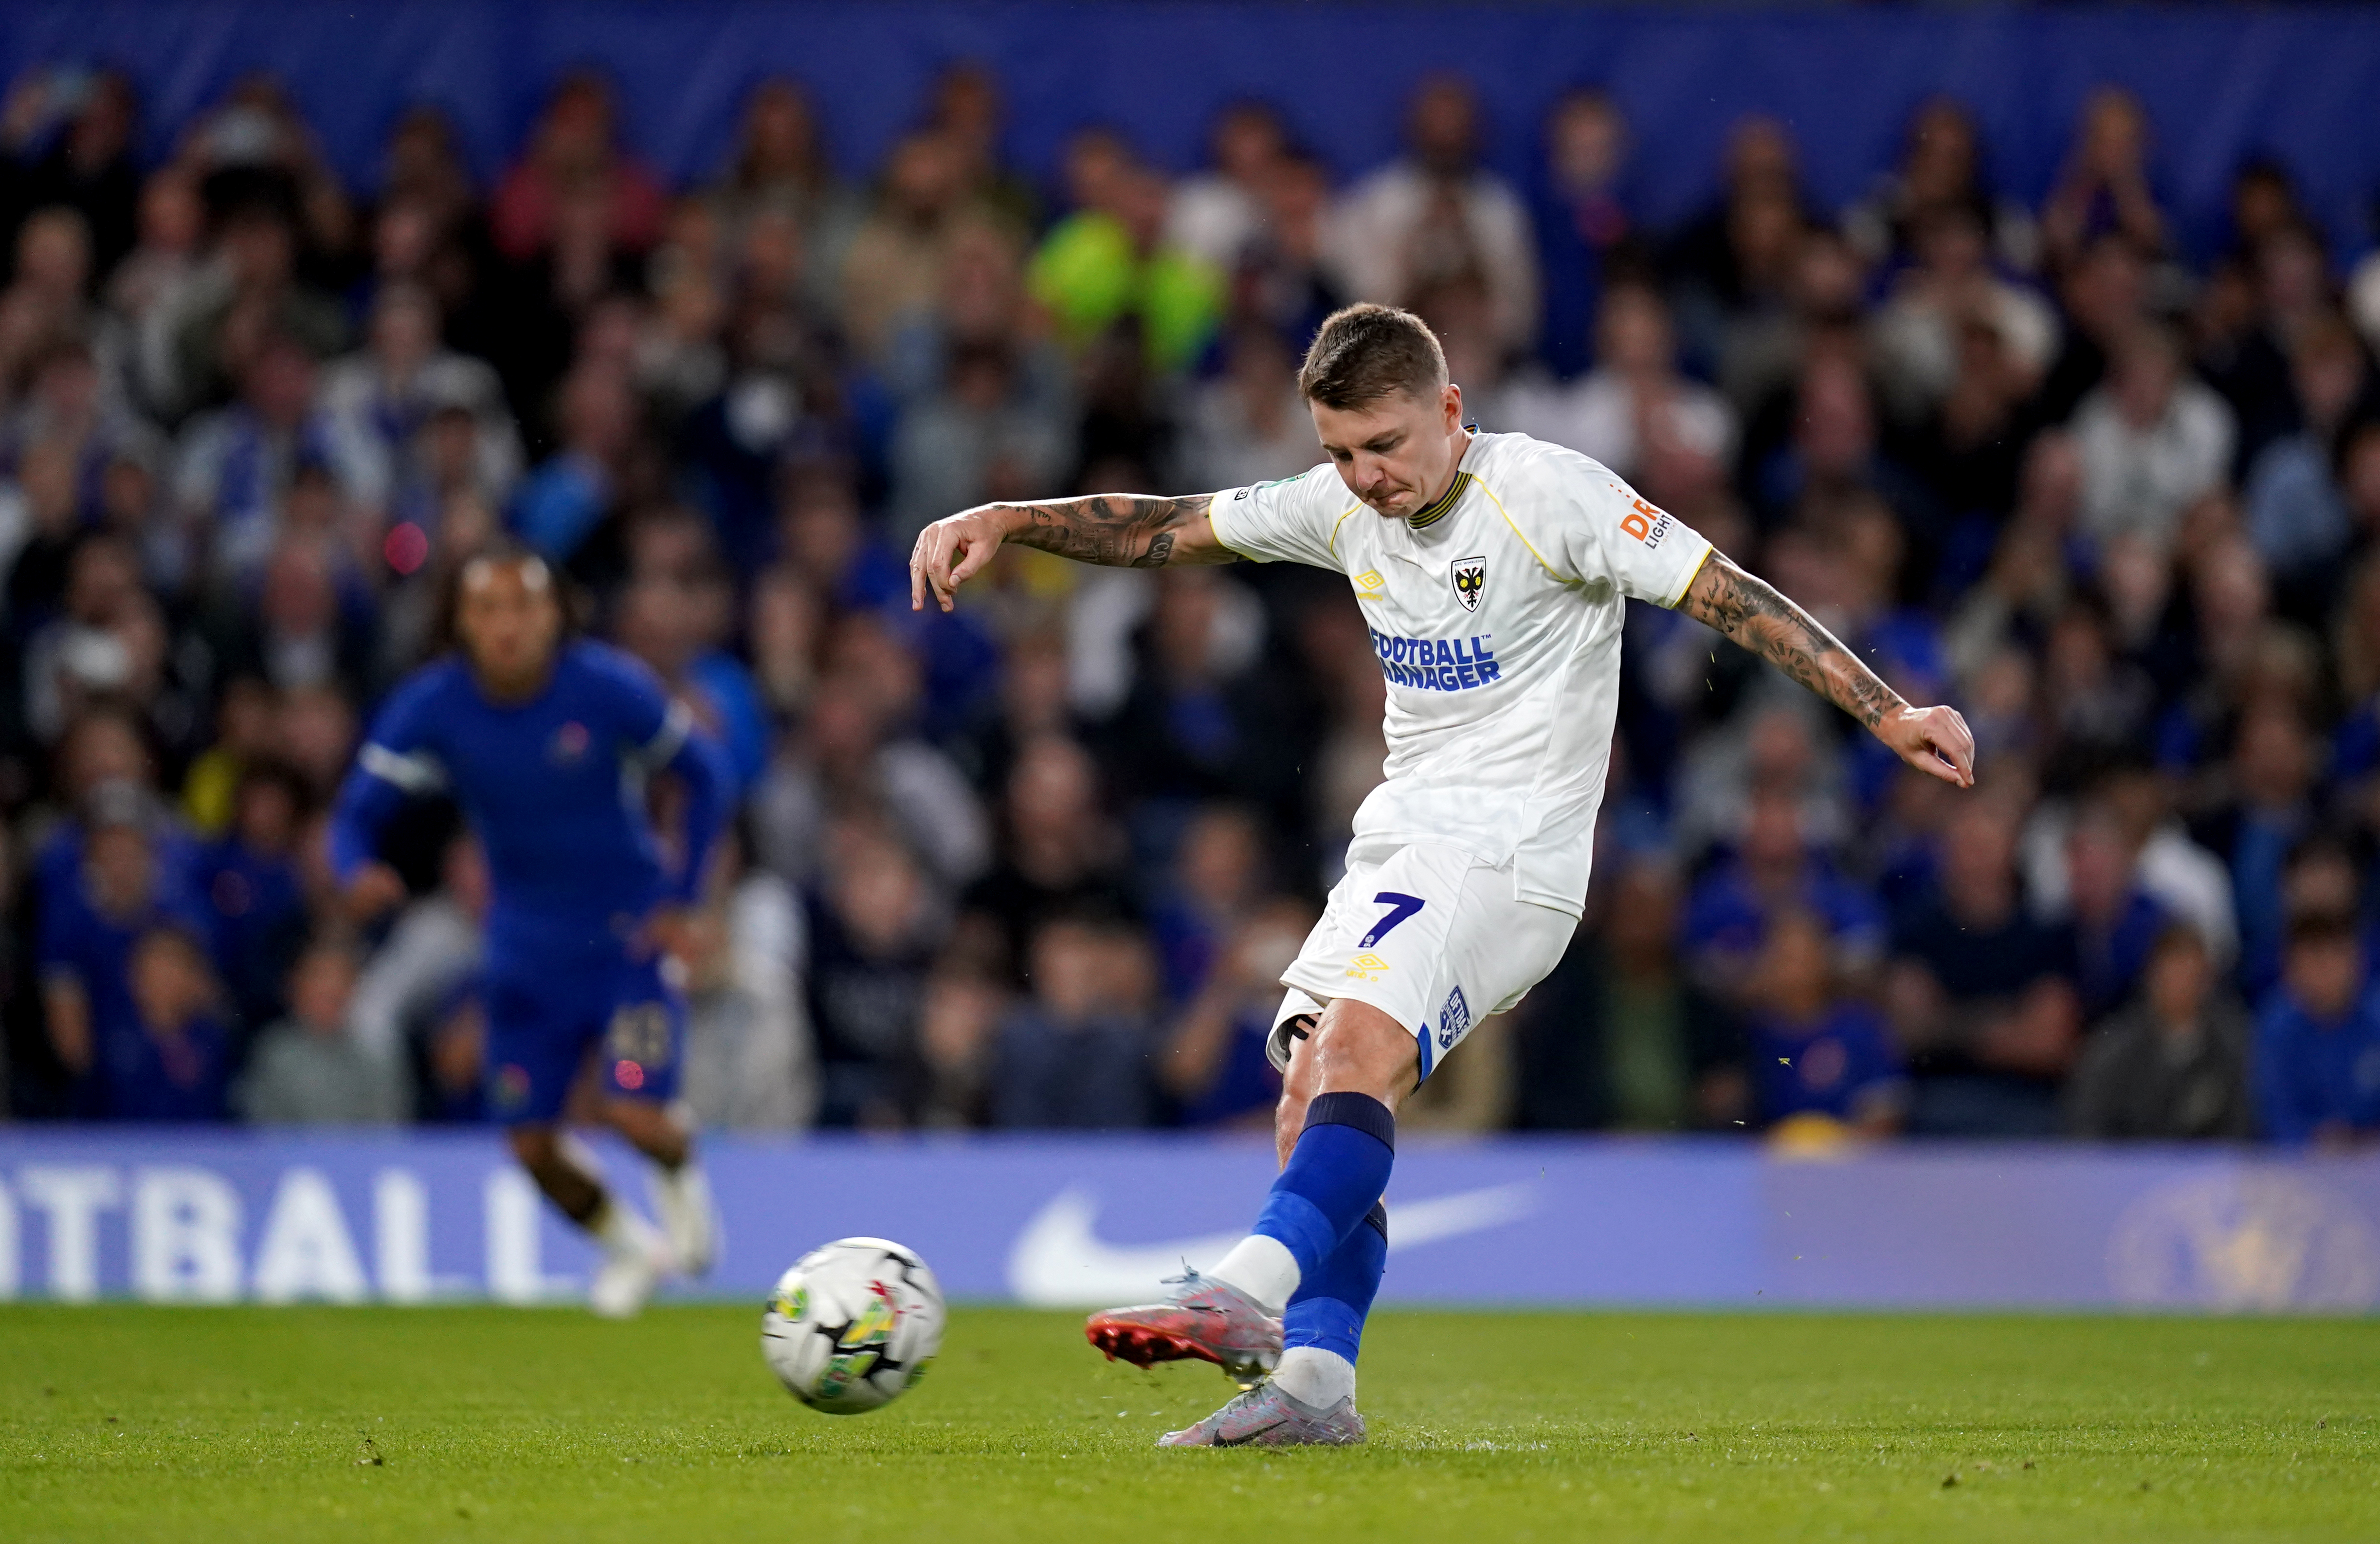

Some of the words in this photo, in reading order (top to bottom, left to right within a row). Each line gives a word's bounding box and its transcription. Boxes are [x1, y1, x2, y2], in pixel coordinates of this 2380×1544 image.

[1370, 626, 1493, 666] FOOTBALL
[1358, 892, 1426, 948] 7
[1346, 969, 1379, 982] umbo
